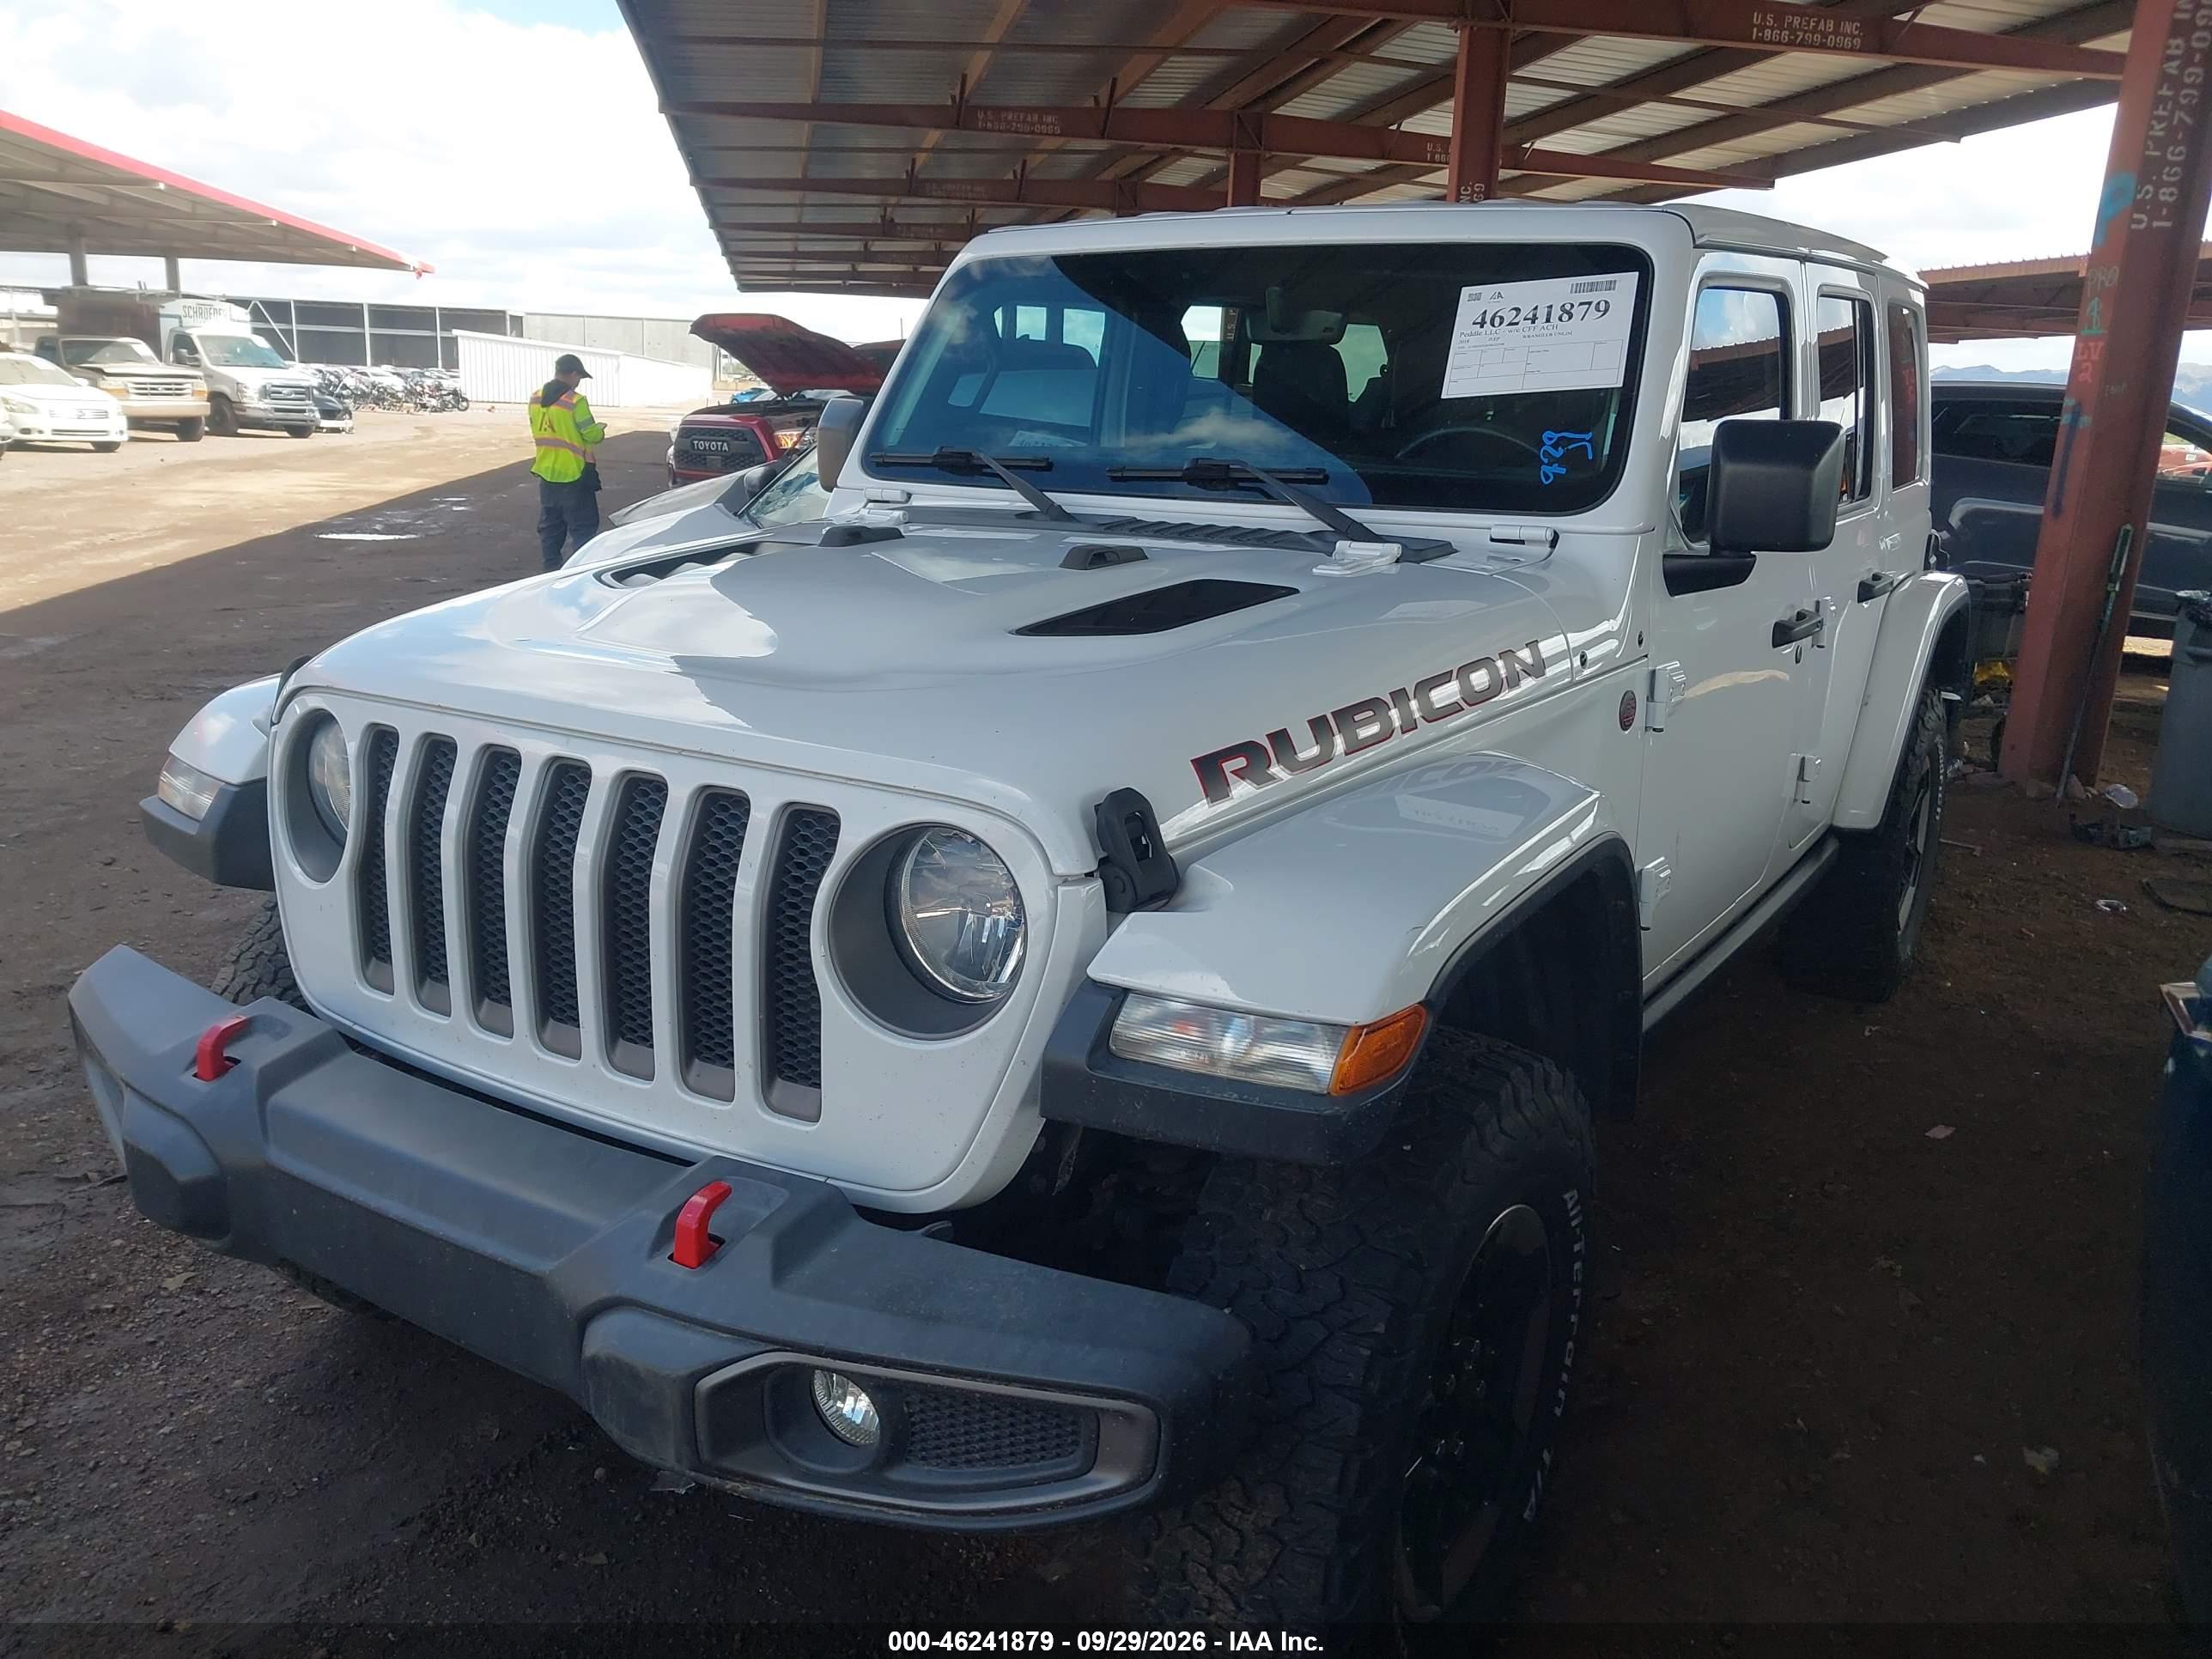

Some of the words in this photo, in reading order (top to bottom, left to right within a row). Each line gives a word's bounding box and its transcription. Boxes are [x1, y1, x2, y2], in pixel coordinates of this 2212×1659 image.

[1753, 11, 1778, 28] U.S.
[1784, 15, 1835, 33] PREFAB
[1840, 19, 1863, 35] INC.
[1752, 28, 1862, 51] 1-866-799-0969
[2130, 175, 2156, 230] U.S.
[1472, 299, 1611, 330] 46241879
[1459, 330, 1483, 338] Peddle
[692, 440, 729, 453] TOYOTA
[1190, 639, 1547, 806] RUBICON
